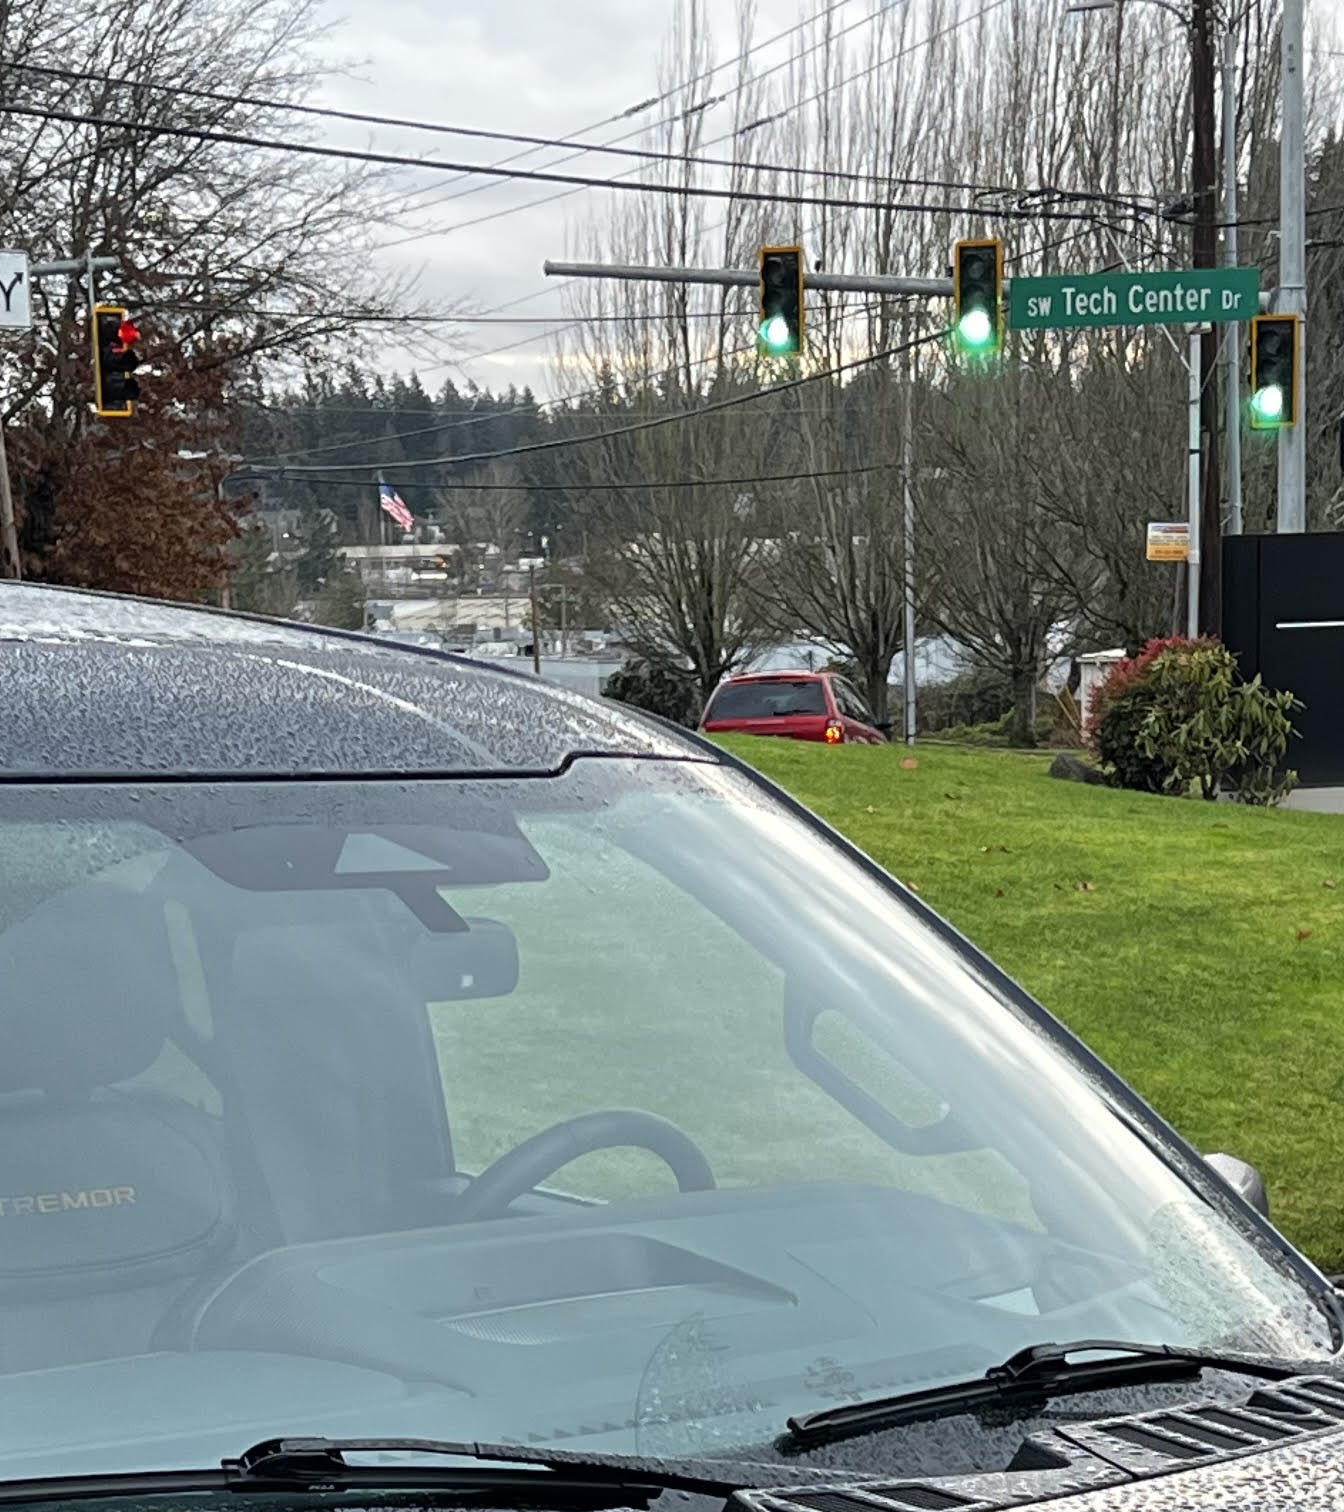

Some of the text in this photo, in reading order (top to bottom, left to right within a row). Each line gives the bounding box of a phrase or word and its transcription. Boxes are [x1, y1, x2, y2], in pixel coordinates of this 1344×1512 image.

[1027, 283, 1242, 318] SW Tech Center Dr
